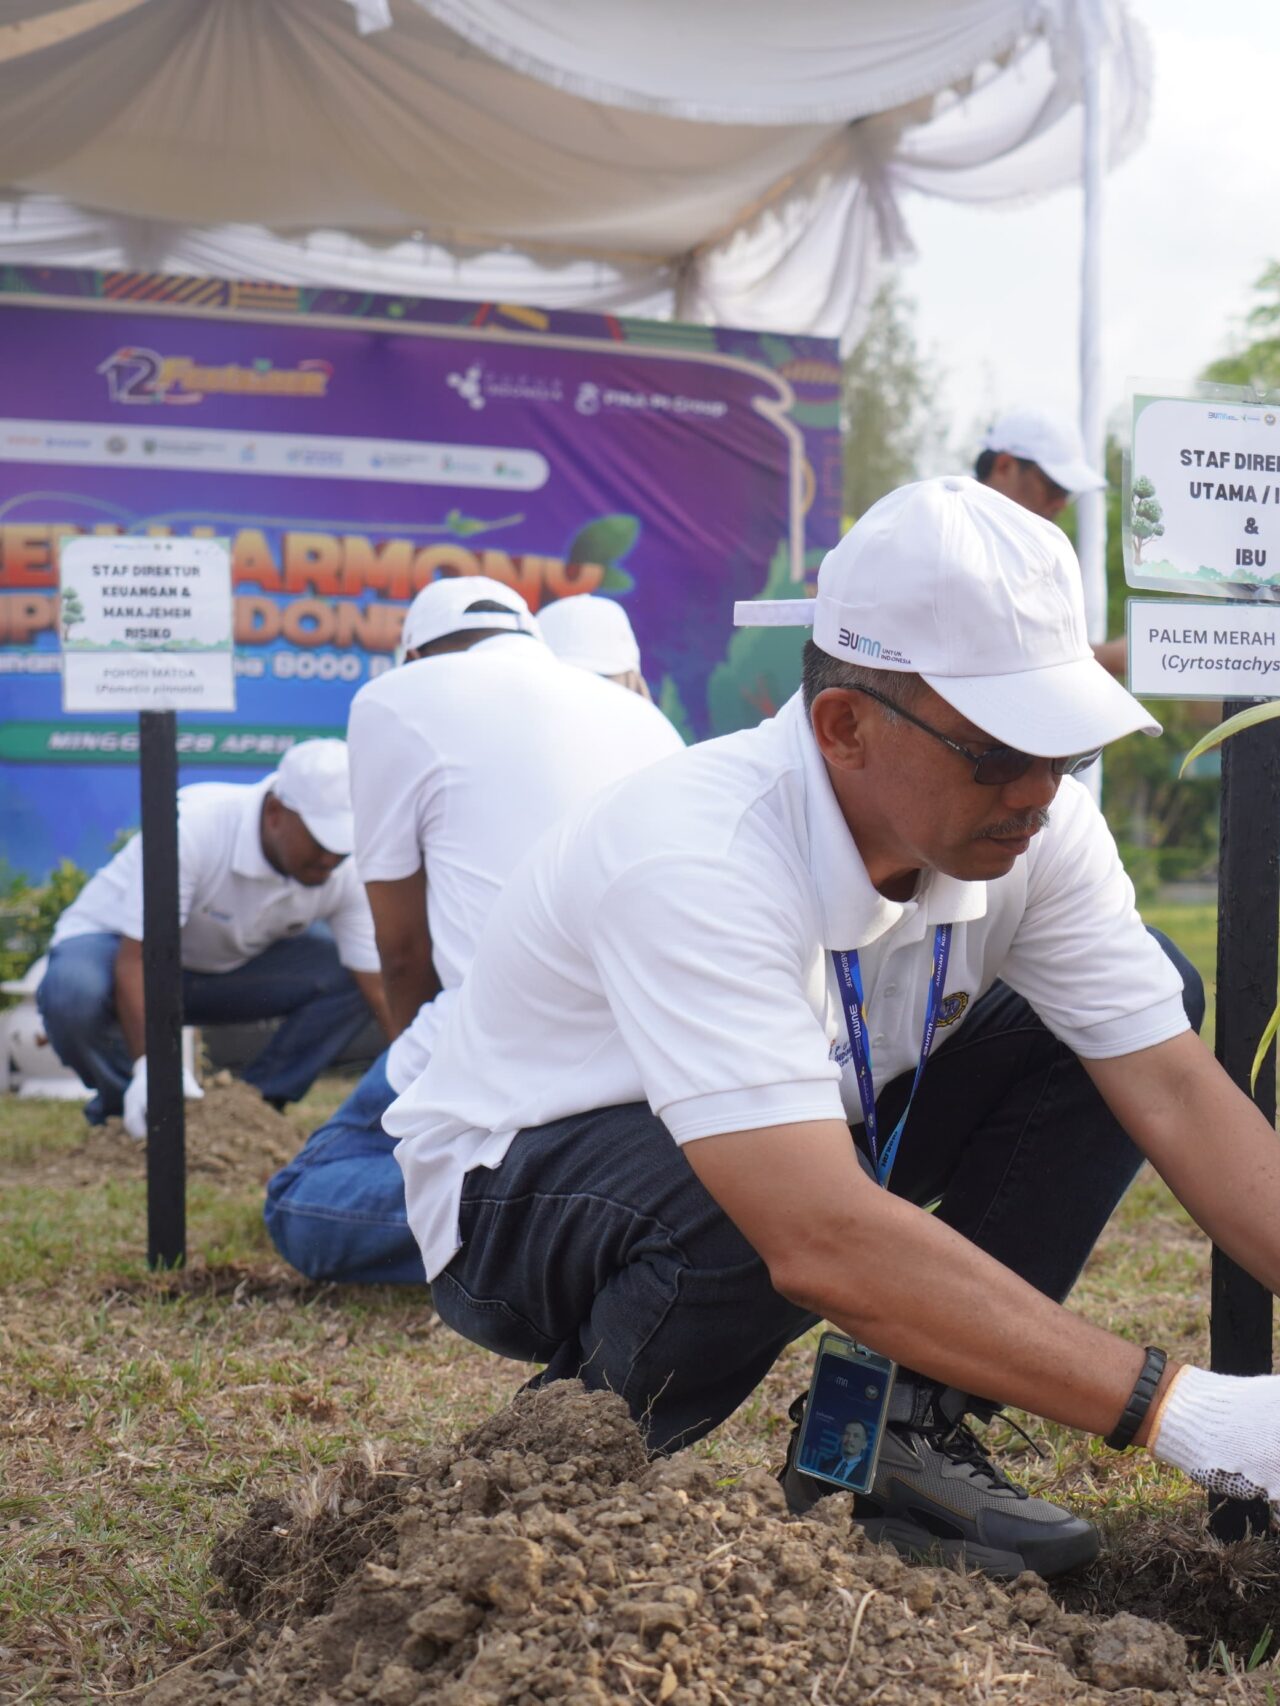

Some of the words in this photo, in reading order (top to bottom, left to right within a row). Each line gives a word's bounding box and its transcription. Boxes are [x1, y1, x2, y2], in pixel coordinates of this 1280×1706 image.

[1180, 449, 1230, 469] STAF
[1189, 481, 1258, 502] UTAMA
[1261, 485, 1271, 505] /
[1244, 517, 1259, 535] &
[1235, 548, 1267, 567] IBU
[92, 565, 129, 576] STAF
[132, 565, 201, 577] DIREKTUR
[102, 587, 177, 597] KEUANGAN
[181, 587, 191, 597] &
[103, 607, 191, 618] MANAJEMEN
[125, 628, 171, 639] RISIKO
[1149, 629, 1208, 645] PALEM
[1213, 630, 1276, 646] MERAH
[1161, 654, 1280, 674] (Cyrtostachys
